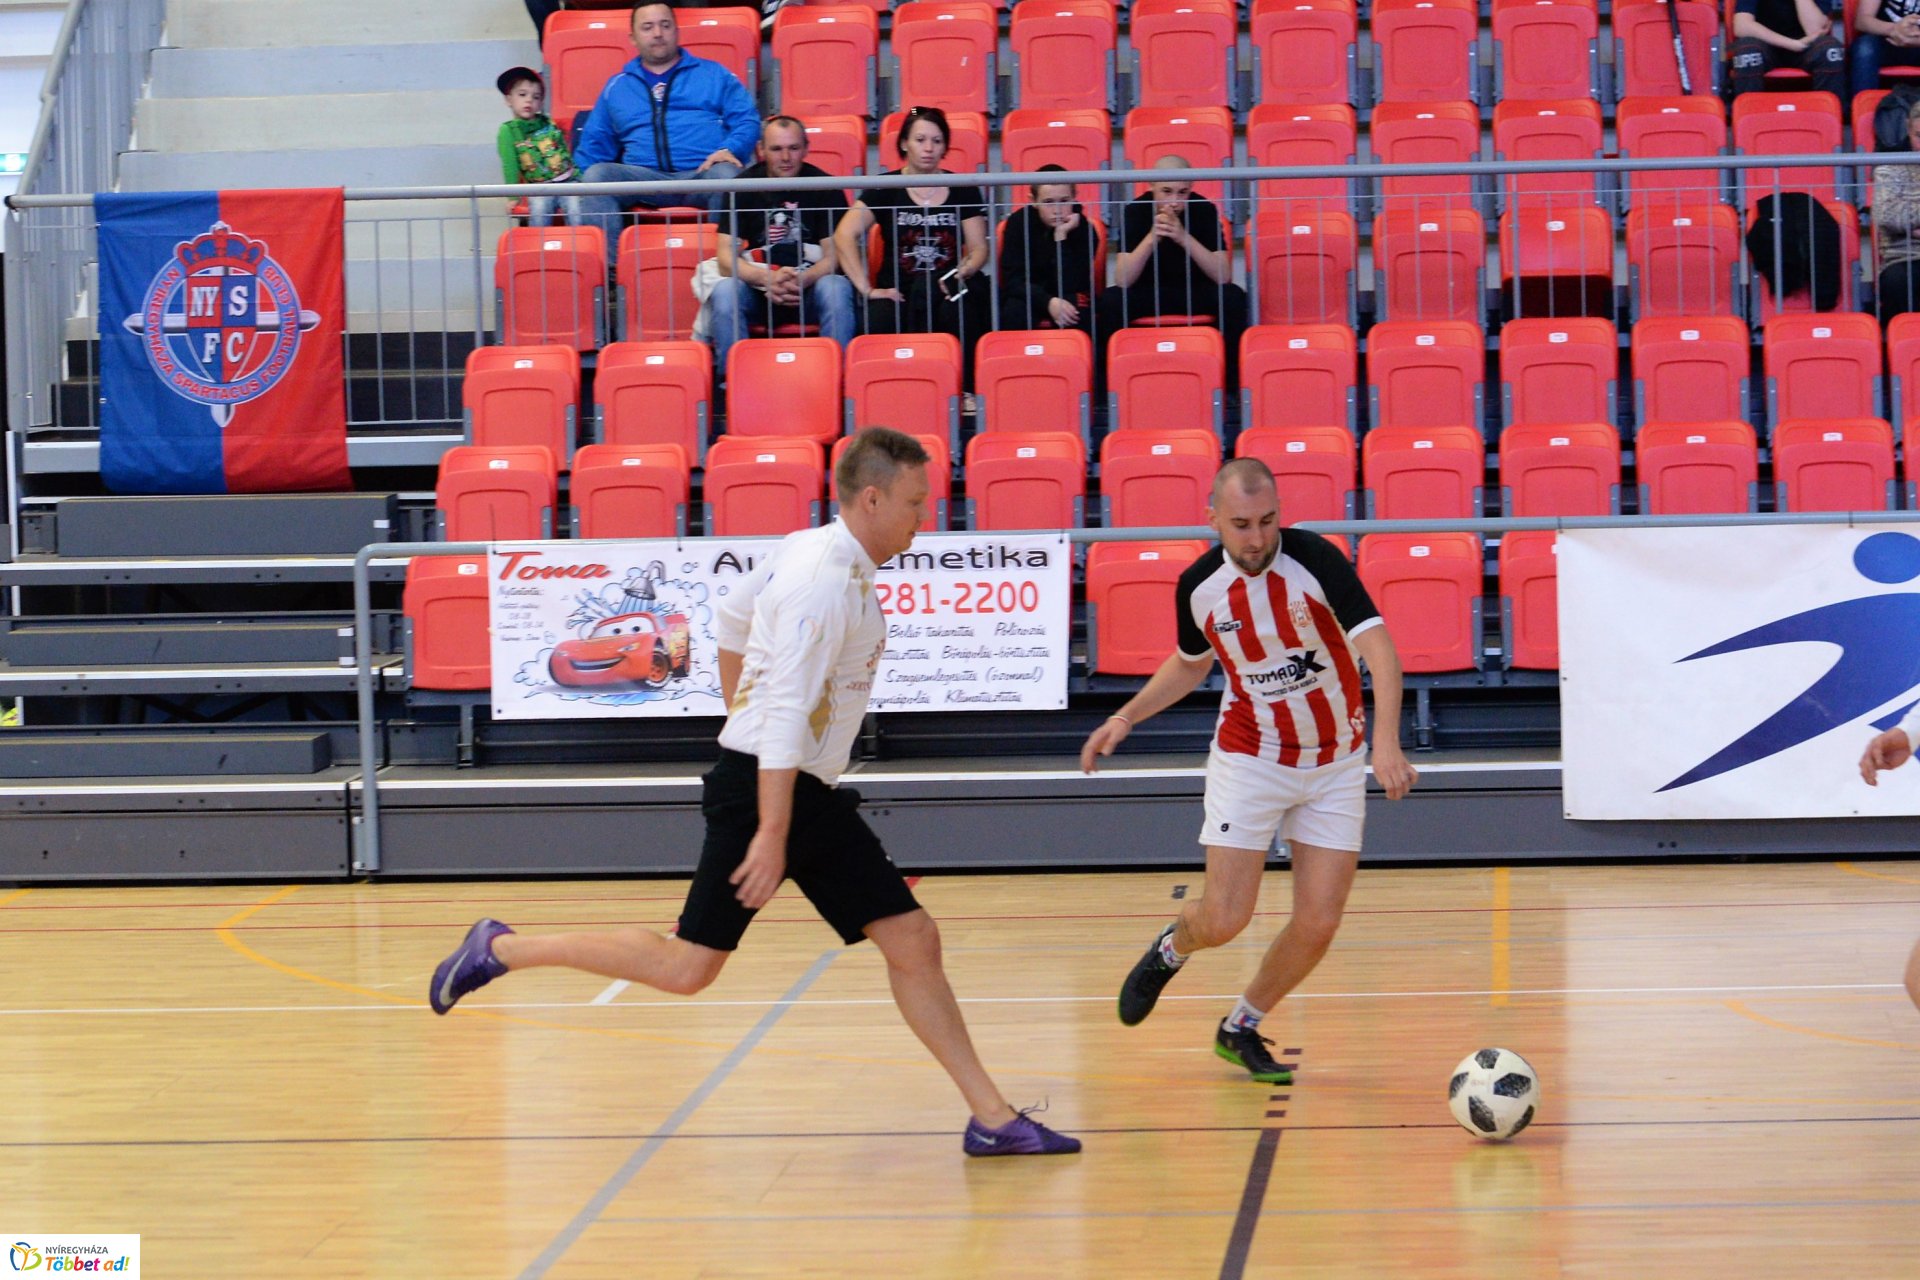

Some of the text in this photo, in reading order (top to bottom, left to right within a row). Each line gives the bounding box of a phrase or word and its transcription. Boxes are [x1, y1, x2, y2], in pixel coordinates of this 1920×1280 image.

[190, 285, 249, 317] NY S
[264, 266, 292, 304] CLUB
[202, 332, 245, 364] F C
[261, 306, 296, 385] FOOTBALL
[172, 372, 261, 400] SPARTACUS
[497, 551, 612, 581] Toma
[875, 580, 1039, 615] 281-2200
[1246, 649, 1328, 685] TOMADEX
